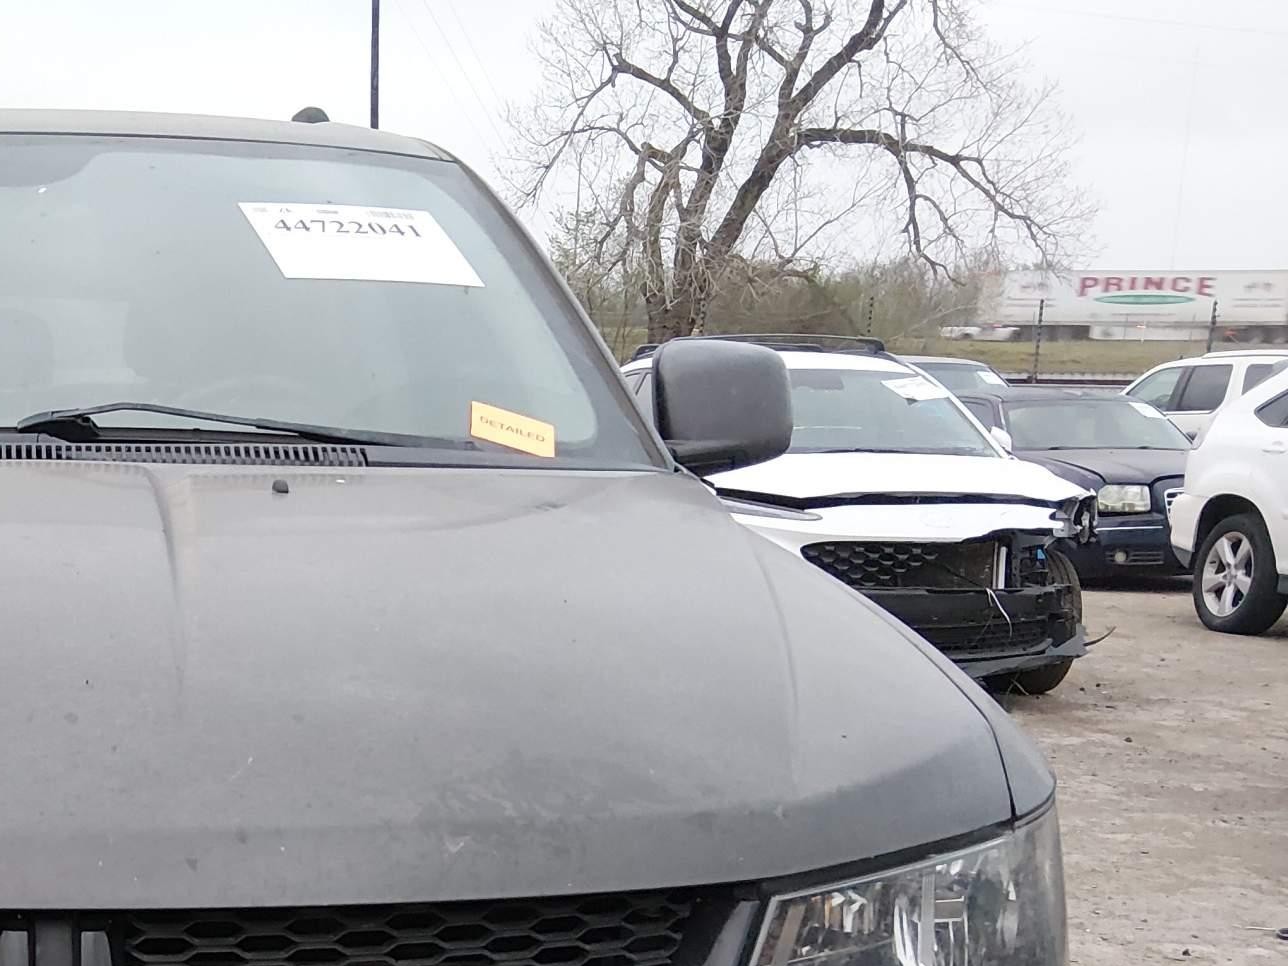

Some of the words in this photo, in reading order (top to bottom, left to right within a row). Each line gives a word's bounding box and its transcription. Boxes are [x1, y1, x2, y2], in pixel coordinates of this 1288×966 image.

[274, 218, 421, 237] 44722041
[1077, 276, 1218, 298] PRINCE
[479, 415, 546, 442] DETAILED
